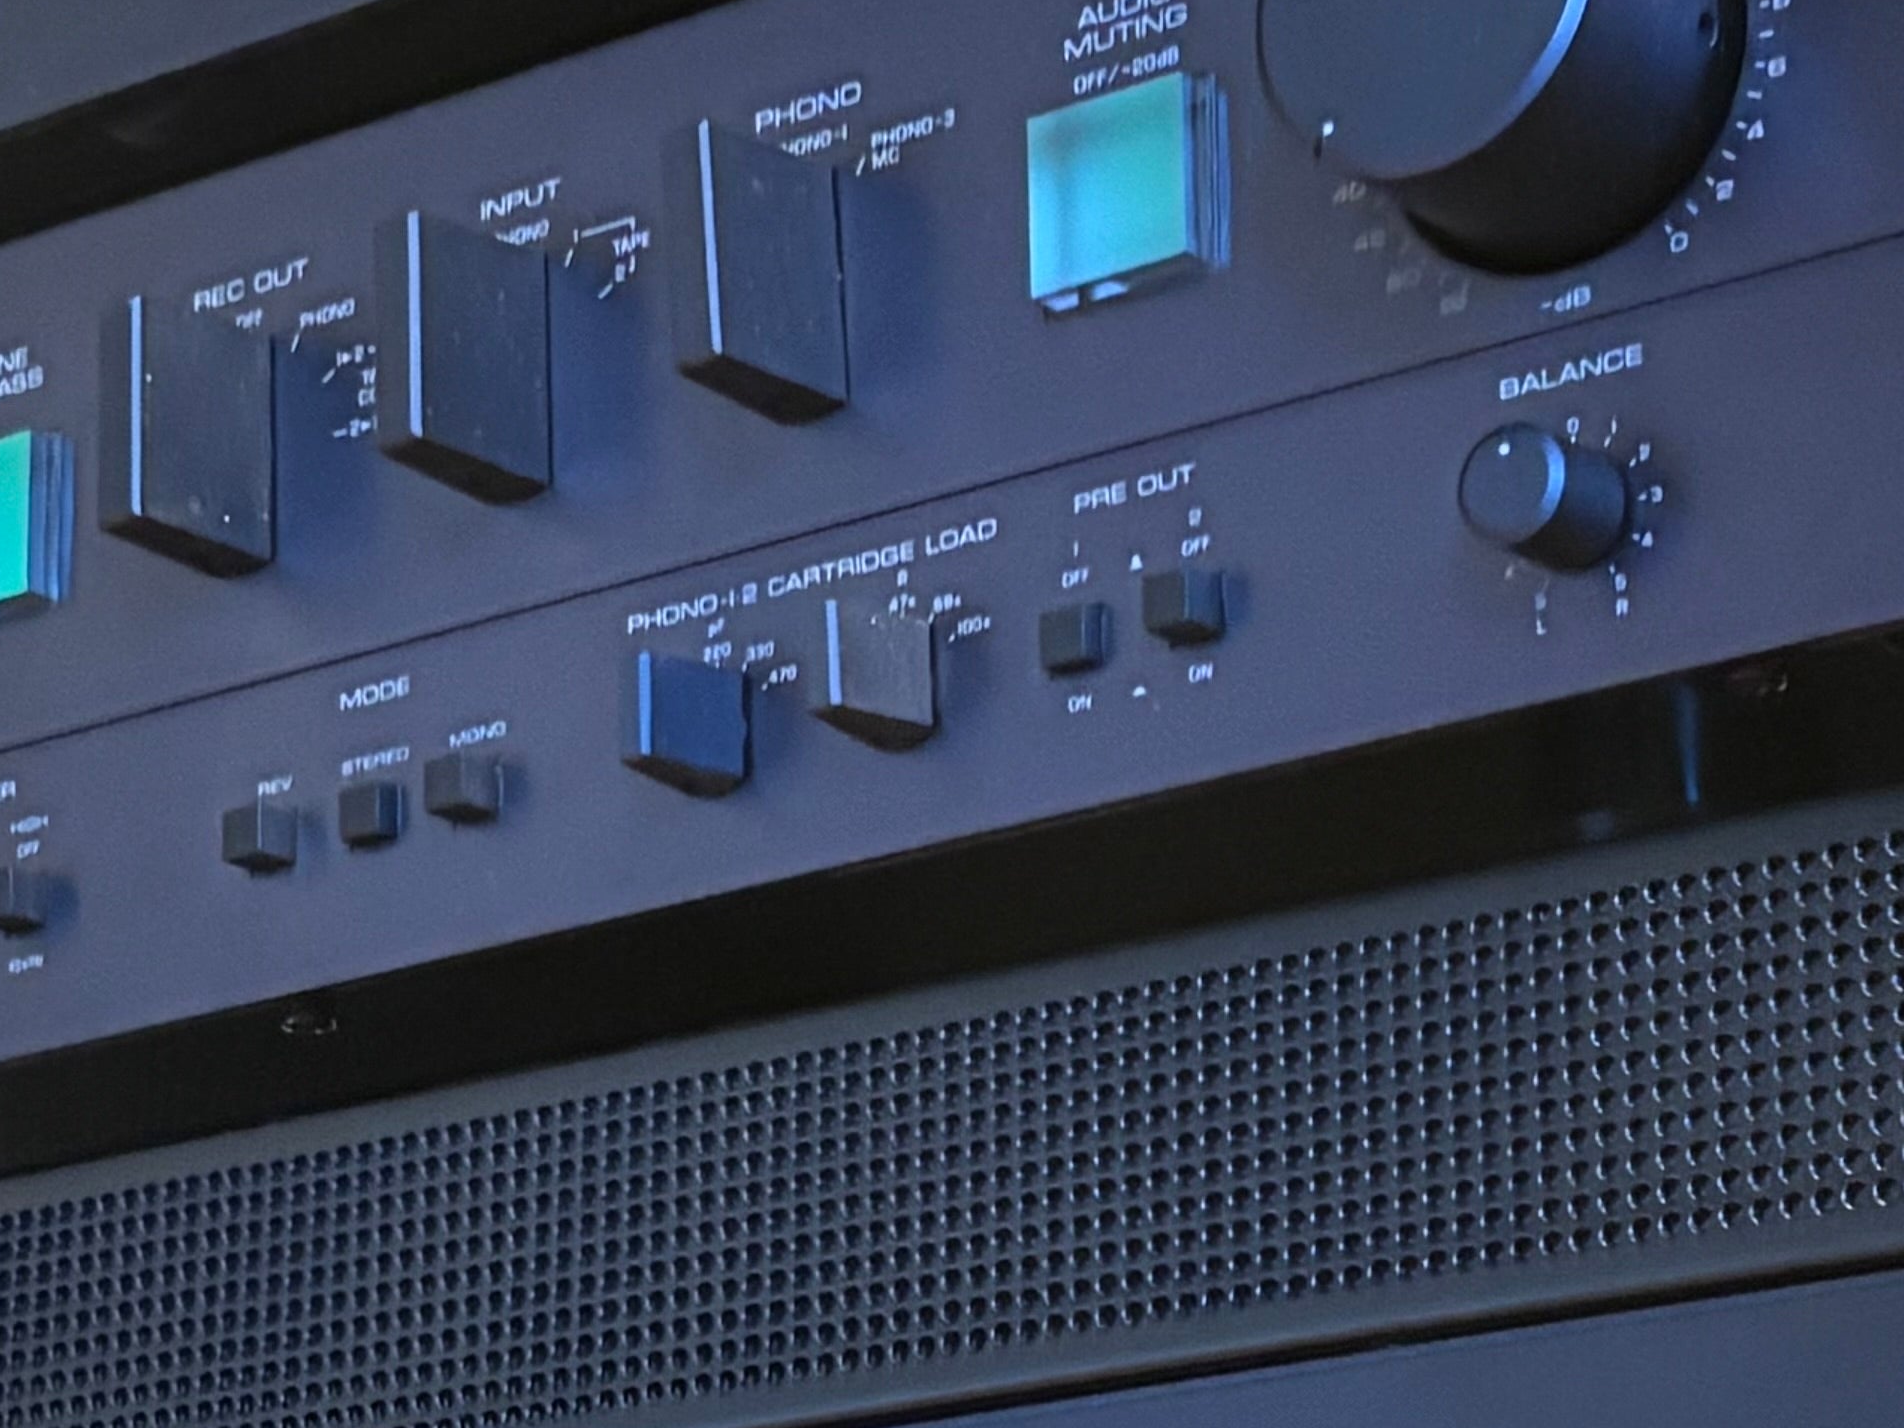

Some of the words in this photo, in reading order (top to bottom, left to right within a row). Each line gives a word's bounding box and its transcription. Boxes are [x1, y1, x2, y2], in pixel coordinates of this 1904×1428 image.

[1063, 2, 1189, 63] MUTING
[754, 80, 862, 135] PHONO
[780, 123, 848, 158] HONO-1
[1746, 119, 1766, 141] 4
[479, 175, 562, 222] INPUT
[495, 218, 550, 247] HONO
[1669, 230, 1690, 254] 0
[194, 277, 245, 313] REC
[253, 256, 310, 295] OUT
[1541, 283, 1592, 316] -dB
[298, 297, 356, 329] PHONO
[1498, 342, 1644, 400] BALANCE
[1566, 415, 1580, 435] 0
[1073, 480, 1127, 515] PRE
[1137, 462, 1194, 498] OUT
[767, 539, 915, 599] CARTRIDGE
[925, 517, 998, 557] LOAD
[1181, 534, 1211, 557] OFF
[1061, 566, 1090, 589] OFF
[1188, 662, 1214, 684] ON
[339, 674, 412, 713] MODE
[1067, 694, 1093, 714] ON
[449, 720, 508, 750] MONO
[341, 745, 412, 778] STEREO
[257, 772, 294, 798] REV
